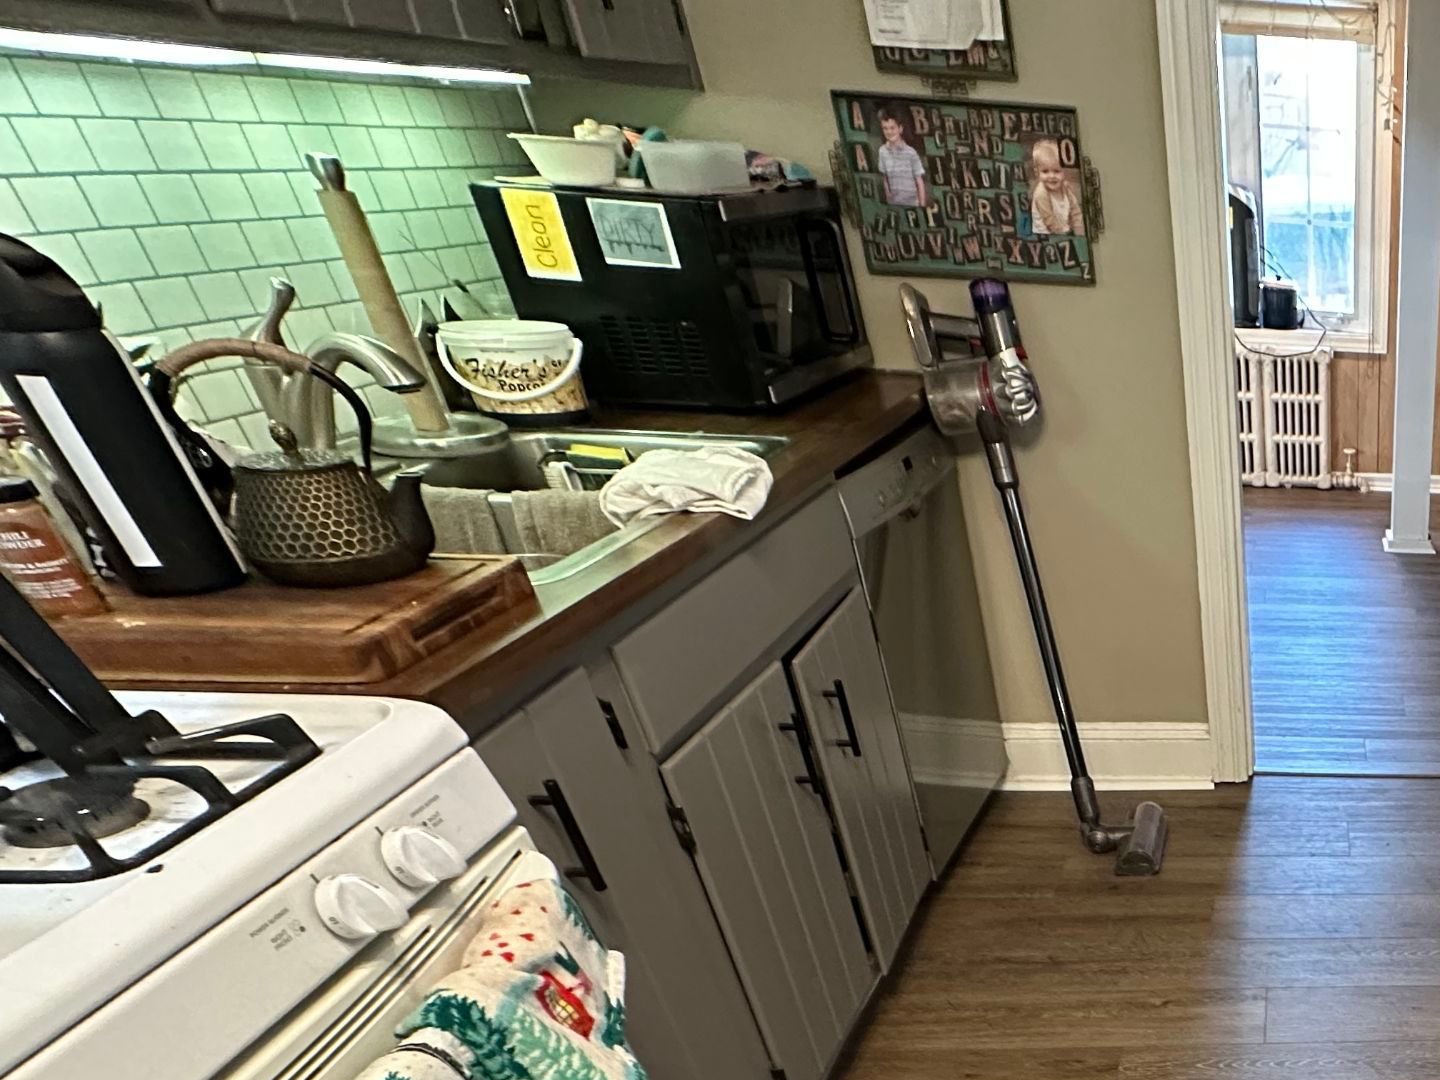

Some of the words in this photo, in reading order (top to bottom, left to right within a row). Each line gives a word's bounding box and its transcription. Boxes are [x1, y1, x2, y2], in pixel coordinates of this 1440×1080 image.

[978, 198, 995, 225] R
[524, 204, 559, 269] Clean
[600, 218, 657, 246] DIRTY
[464, 358, 547, 380] Fisher's
